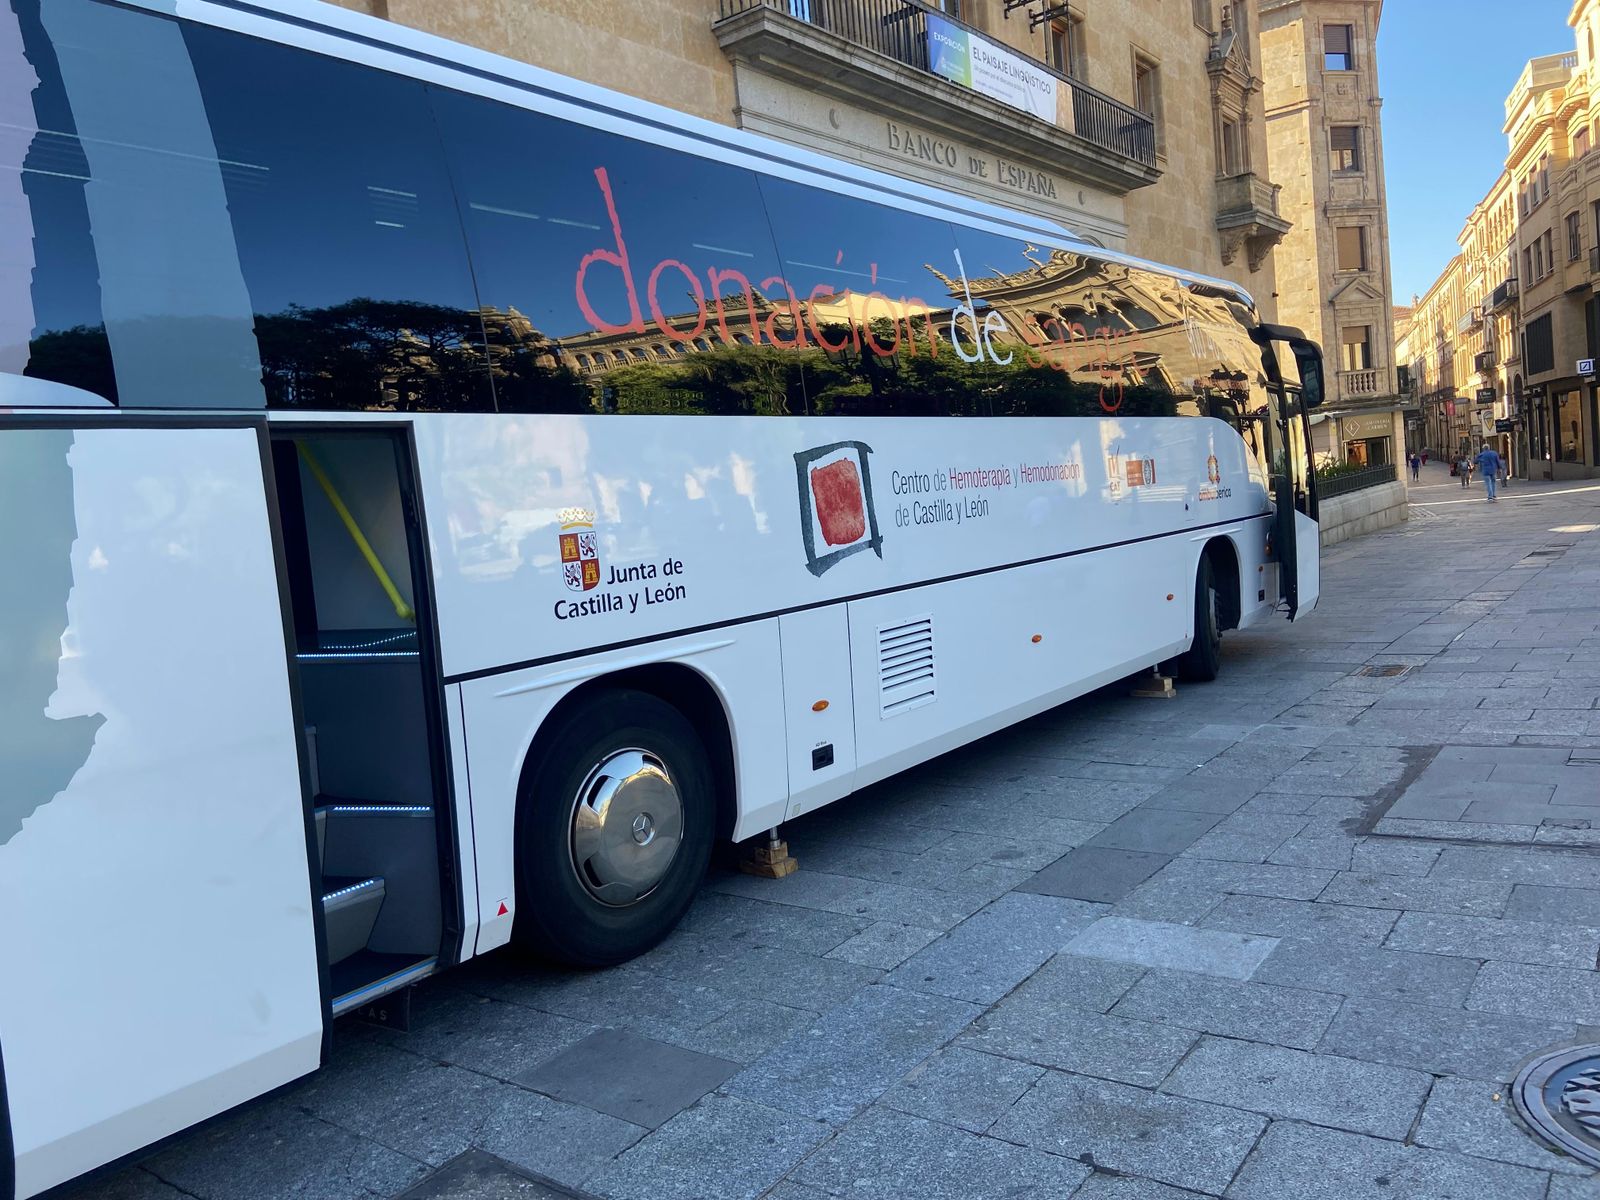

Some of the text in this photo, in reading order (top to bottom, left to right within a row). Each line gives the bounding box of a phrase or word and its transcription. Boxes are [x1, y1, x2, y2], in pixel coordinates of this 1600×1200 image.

[933, 32, 966, 53] EXPOSICIÓN
[973, 46, 981, 61] EL
[982, 52, 1008, 75] PAISAJE
[887, 122, 1057, 199] BANCO DE ESPAÑA
[576, 167, 1150, 412] donación de sangre
[892, 460, 1081, 495] Centro de Hemoterapia y Hemodonación
[895, 494, 989, 527] de Castilla y León
[606, 557, 683, 585] Junta de
[554, 582, 686, 620] Castilla y León
